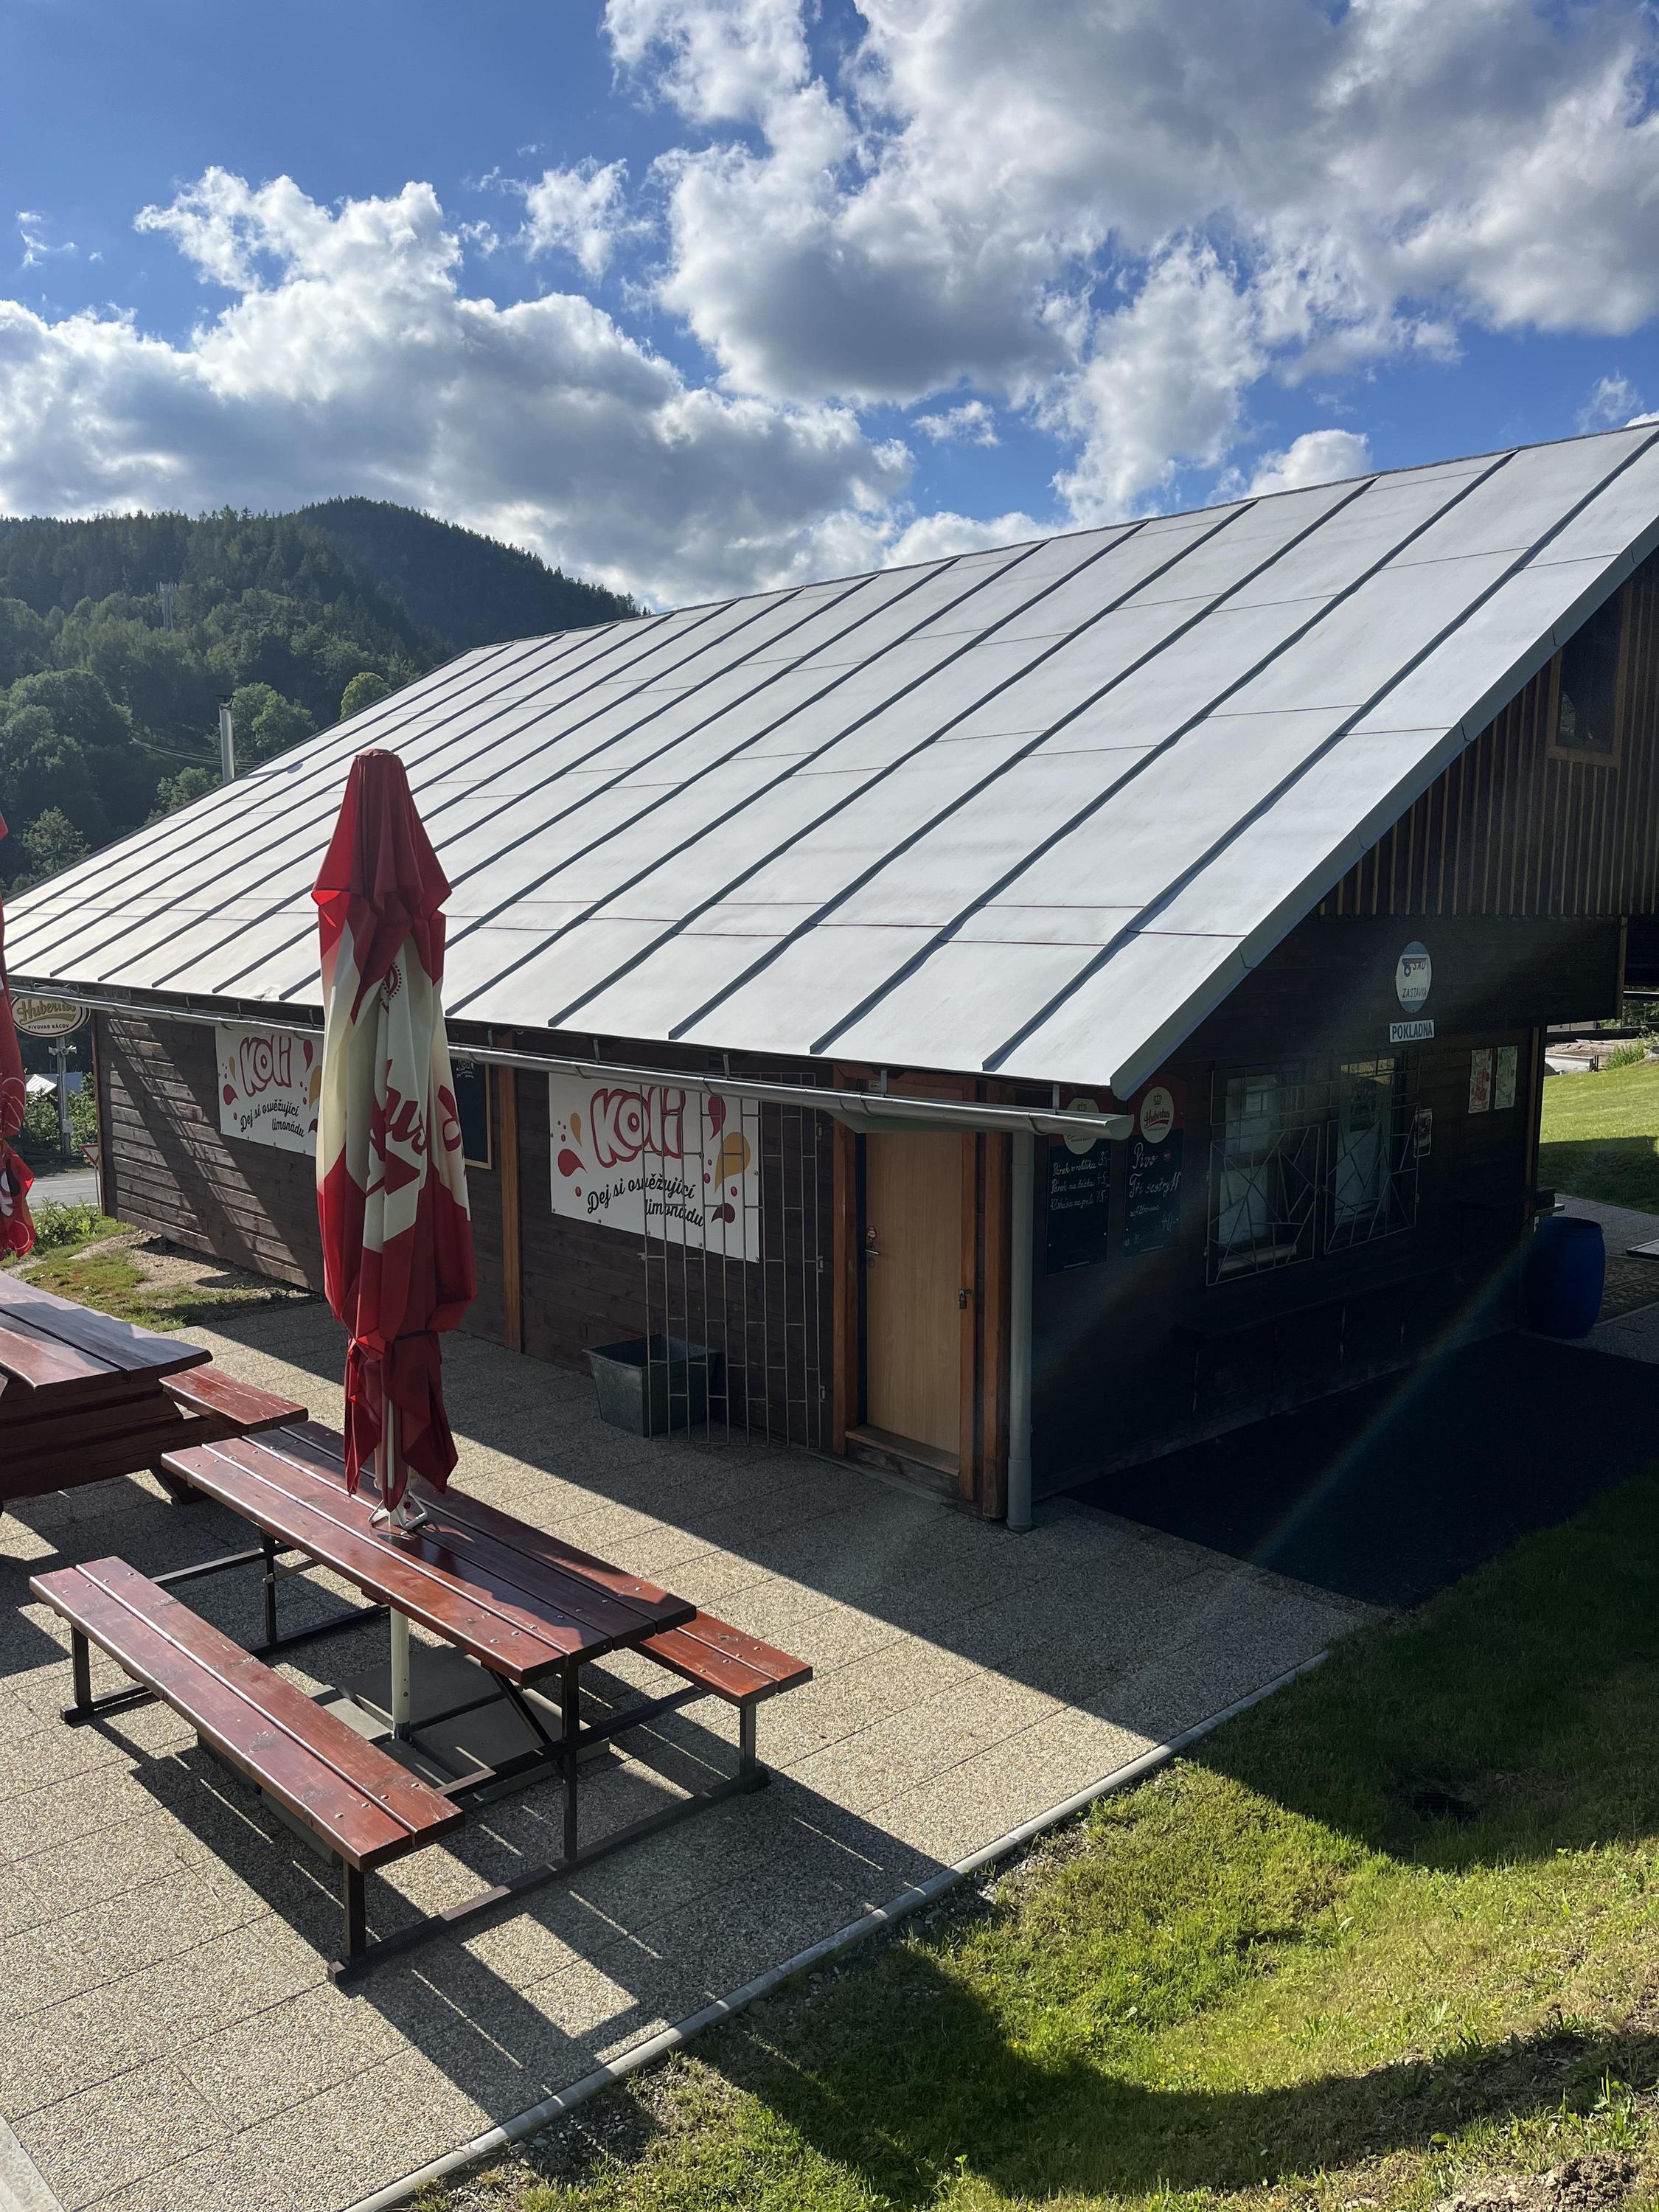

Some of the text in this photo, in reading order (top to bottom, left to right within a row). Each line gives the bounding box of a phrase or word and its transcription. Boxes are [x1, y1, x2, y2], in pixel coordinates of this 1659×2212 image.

[1391, 1022, 1433, 1040] POKLADNA
[240, 1099, 299, 1133] Dej si osvěžující
[271, 1118, 305, 1138] limonádu
[1133, 1142, 1157, 1169] Pivo
[588, 1173, 697, 1214] Dej si osvěžující
[646, 1198, 704, 1227] limonádu
